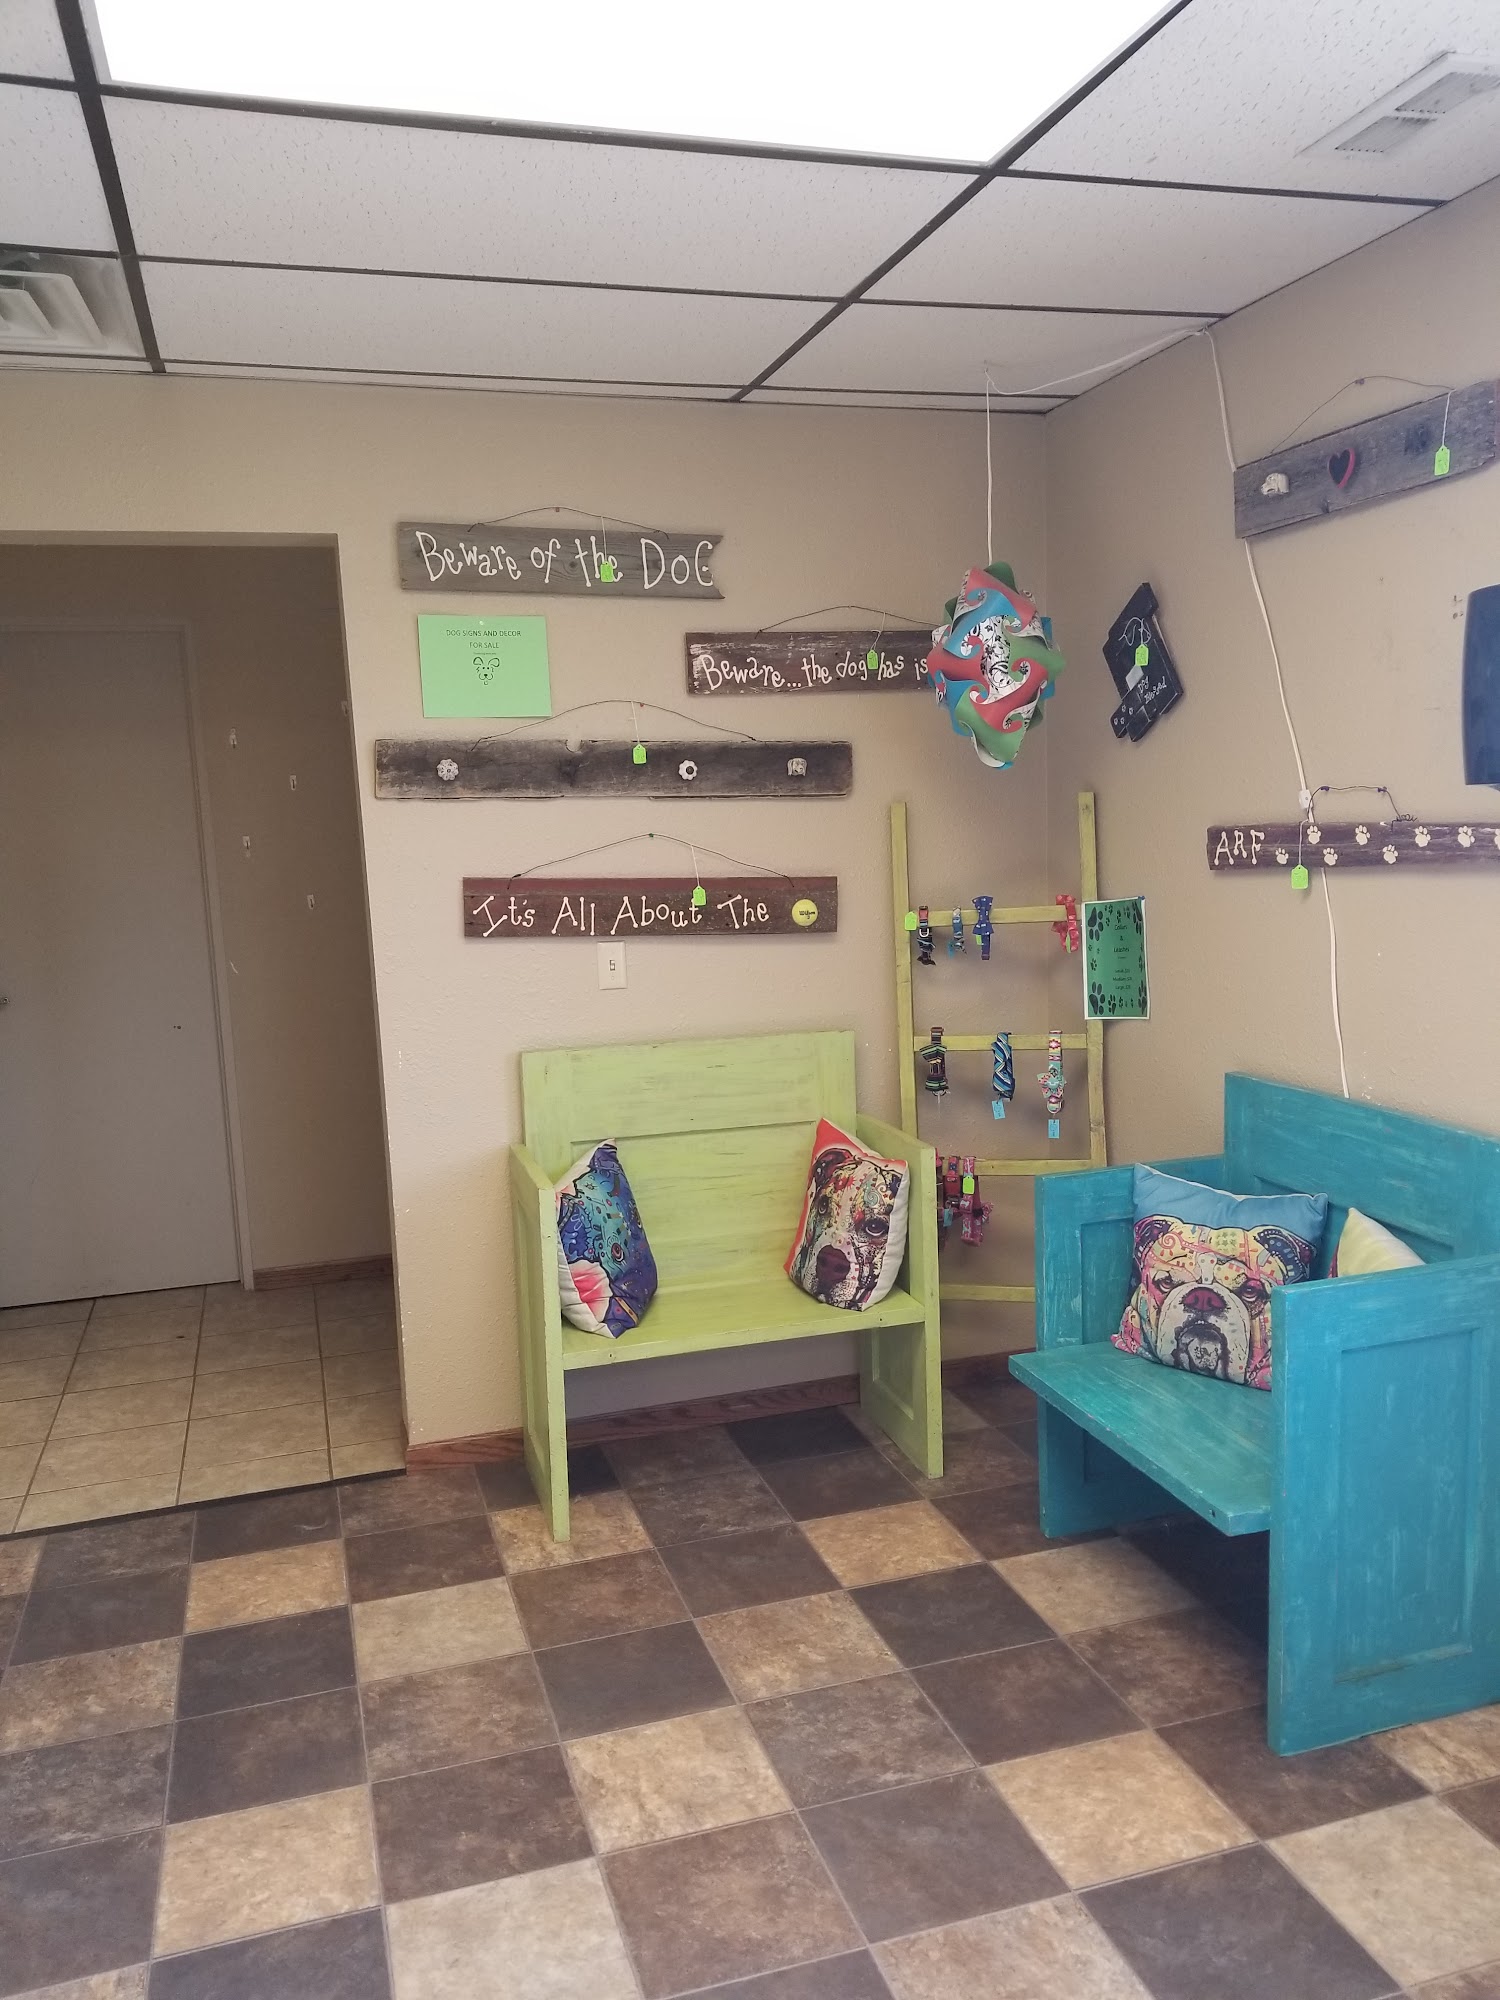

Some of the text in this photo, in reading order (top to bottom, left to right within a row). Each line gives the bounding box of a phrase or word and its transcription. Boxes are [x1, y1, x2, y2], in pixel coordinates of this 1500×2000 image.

[415, 531, 522, 582] Beware
[530, 538, 562, 583] of
[575, 535, 624, 588] the
[446, 629, 461, 637] DOG
[801, 653, 832, 687] the
[835, 651, 868, 681] dog
[877, 651, 905, 681] has
[1213, 829, 1265, 865] ARF
[472, 893, 770, 937] It's All About The
